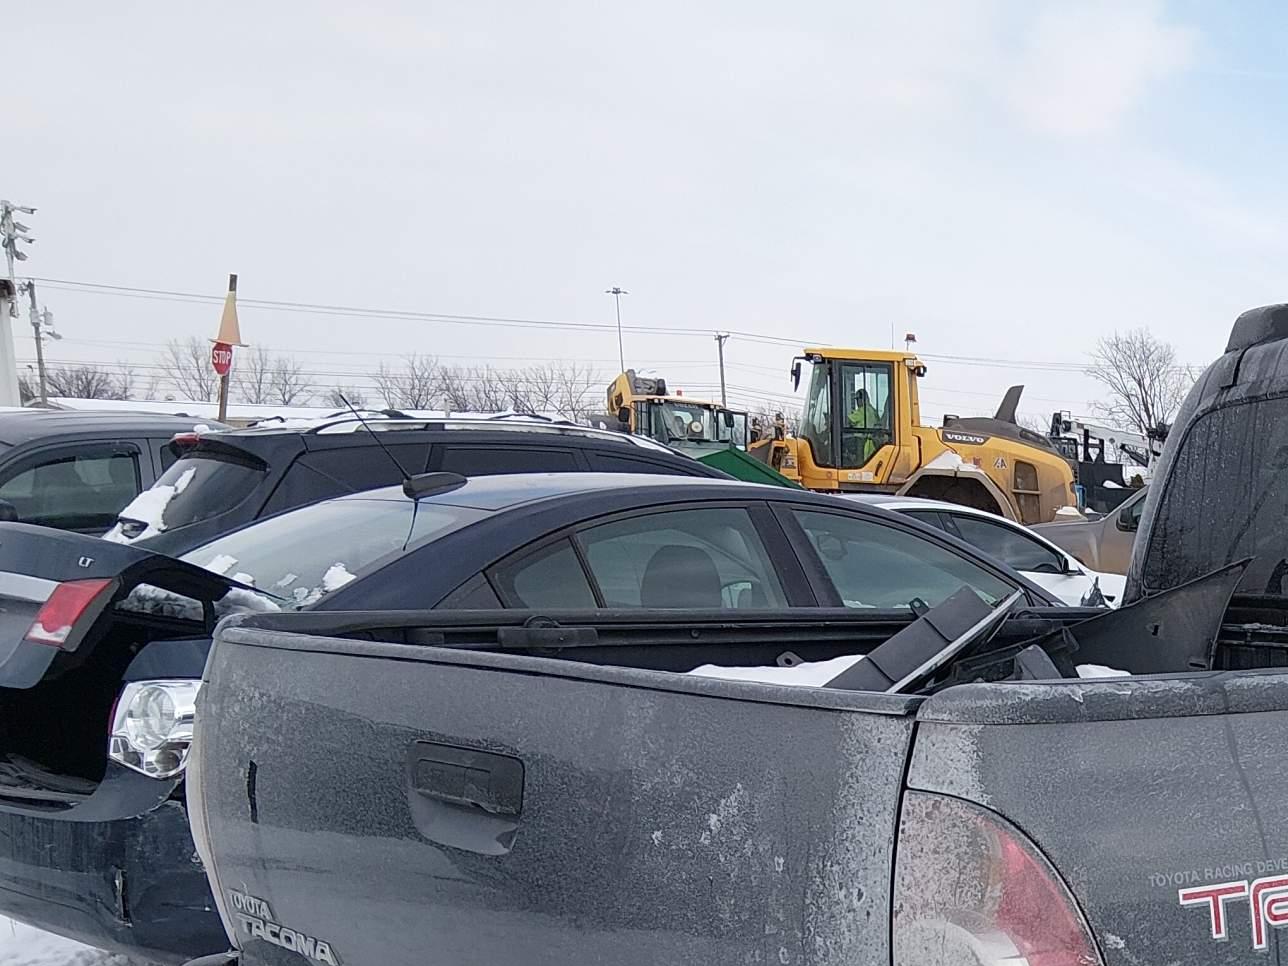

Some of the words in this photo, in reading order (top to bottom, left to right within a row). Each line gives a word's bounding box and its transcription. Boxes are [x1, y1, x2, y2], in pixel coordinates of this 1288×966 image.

[213, 350, 231, 364] STOP
[945, 433, 985, 443] VOLVO
[79, 556, 95, 568] LT
[1149, 869, 1200, 887] TOYOTA
[1204, 862, 1251, 881] RACING
[229, 890, 274, 920] TOYOTA
[237, 913, 341, 966] TACOMA
